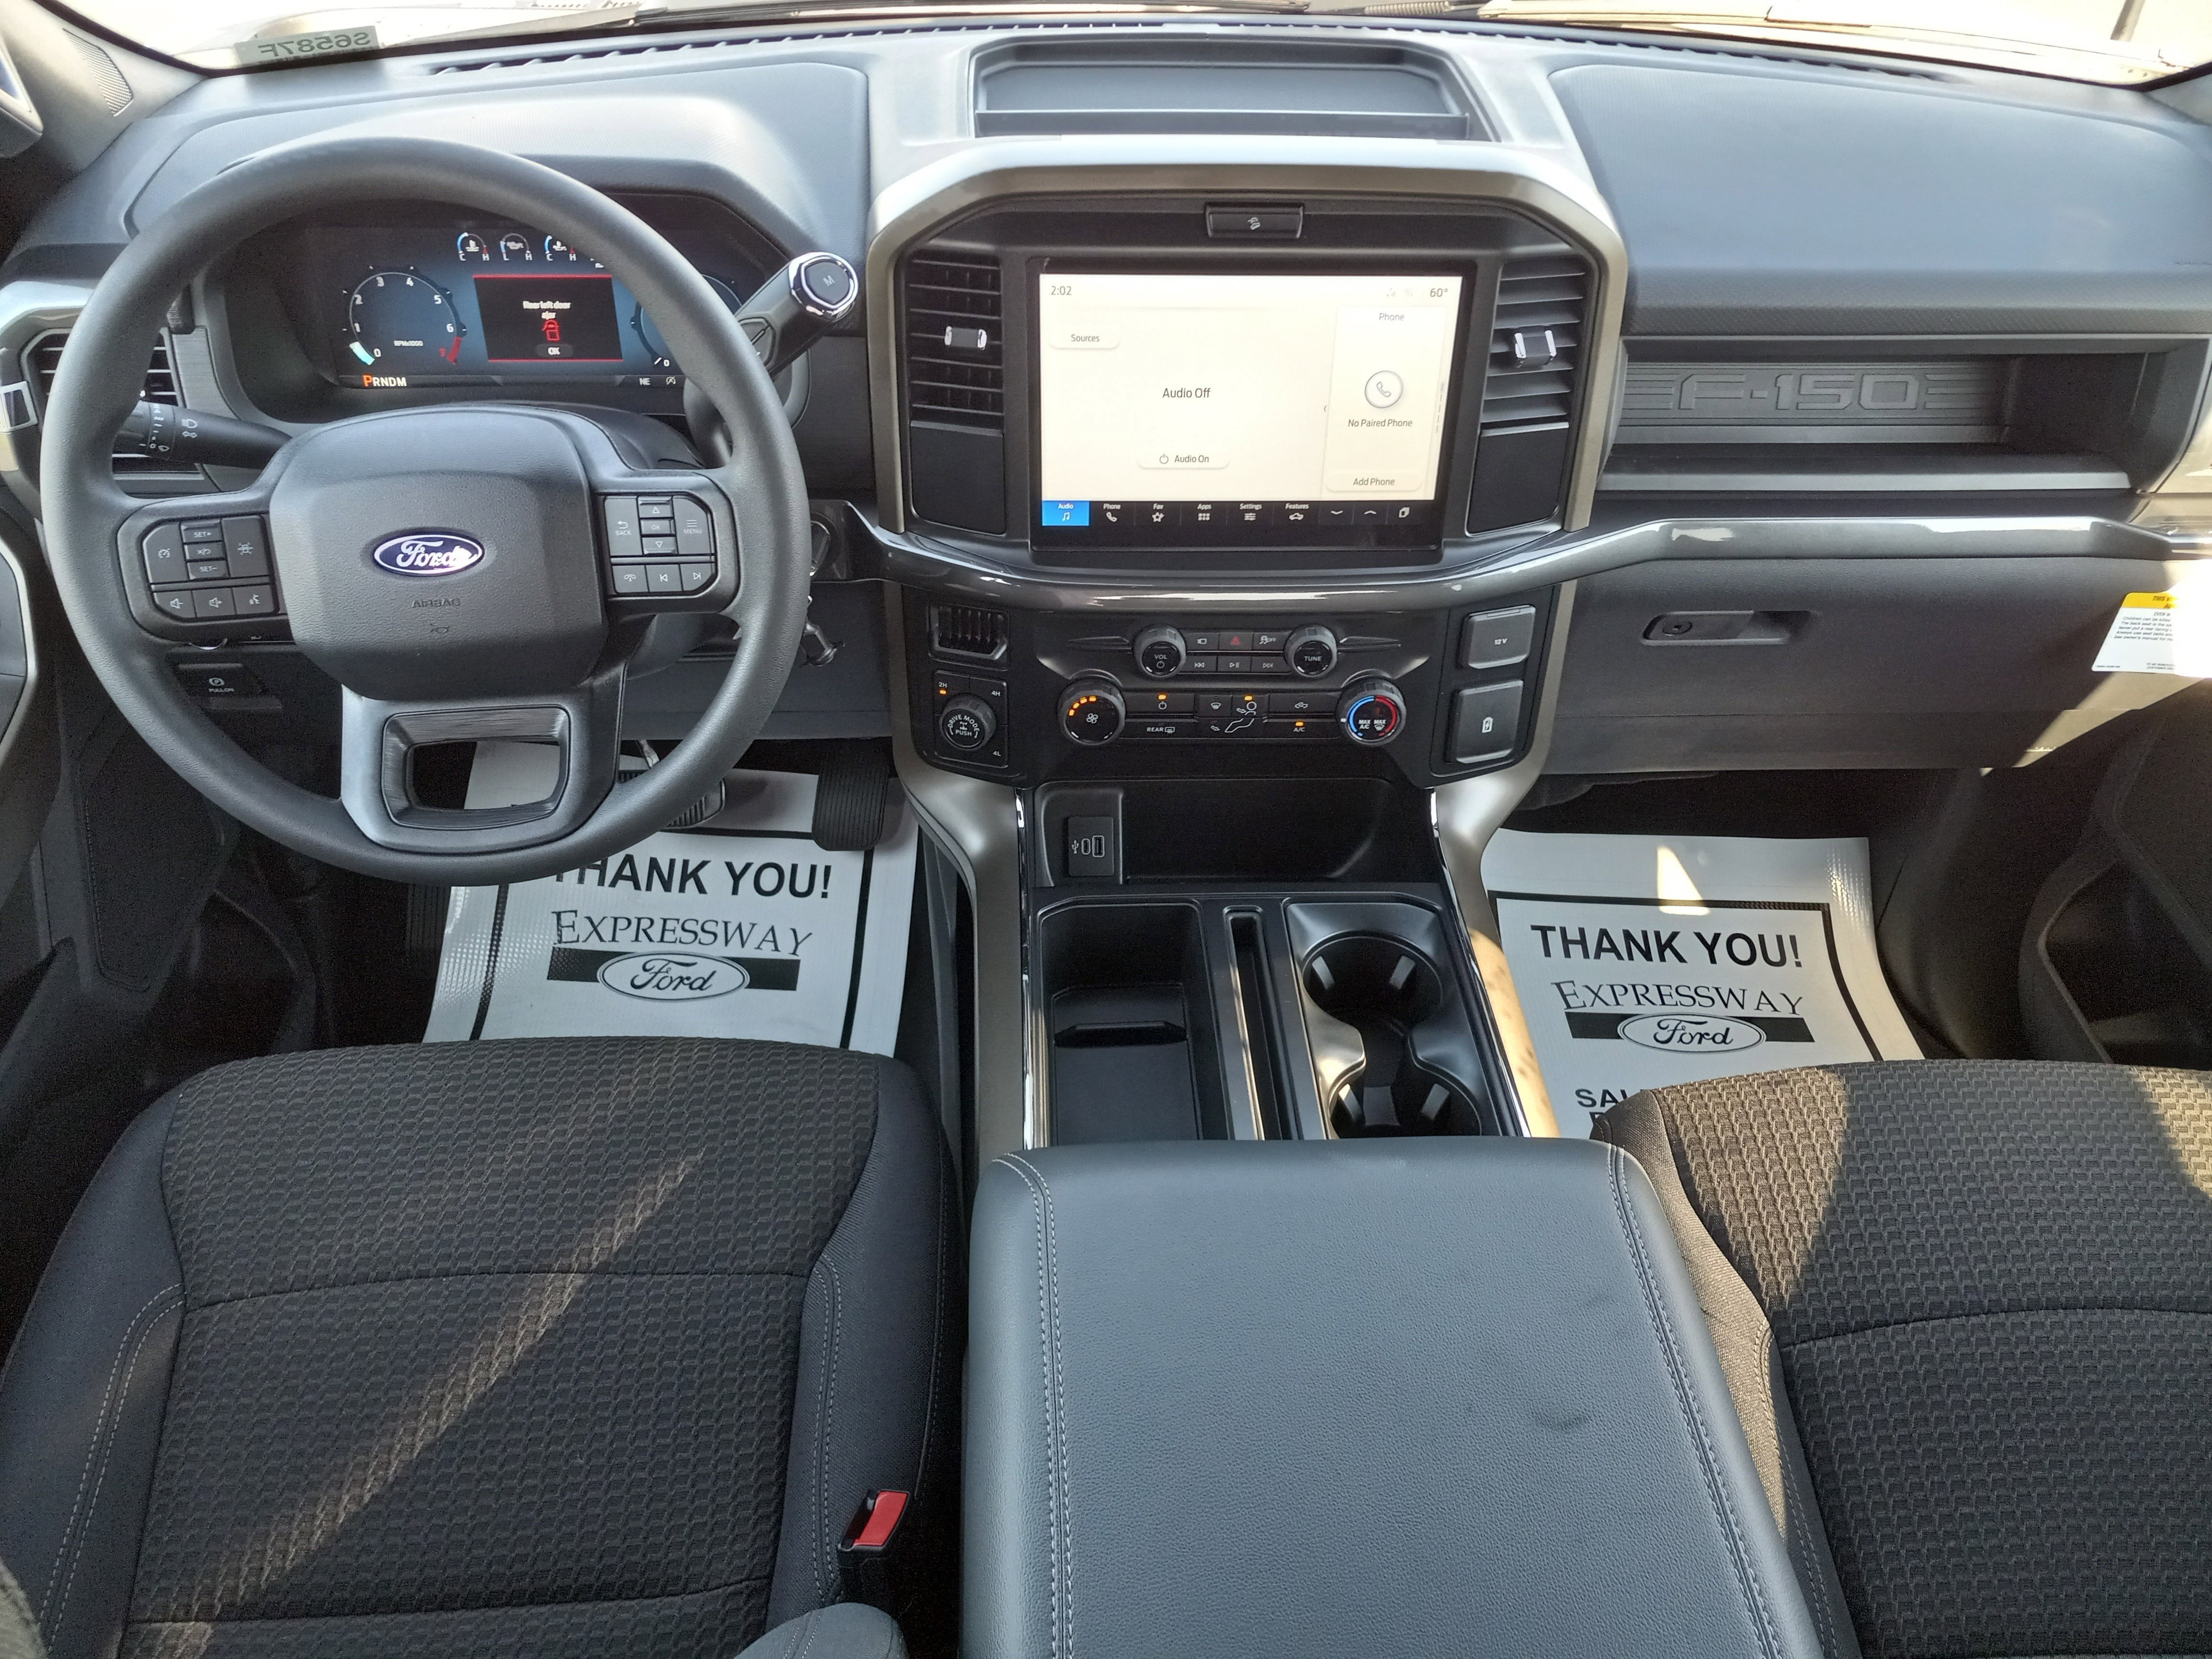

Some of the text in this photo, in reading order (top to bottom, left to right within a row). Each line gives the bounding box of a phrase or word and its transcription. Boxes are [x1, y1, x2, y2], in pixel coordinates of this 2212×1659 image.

[376, 276, 384, 287] 3
[406, 277, 414, 287] 4
[1051, 287, 1072, 296] 2:02
[354, 294, 363, 304] 2
[434, 295, 442, 304] 5
[1379, 313, 1405, 322] Phone
[354, 323, 361, 332] 1
[446, 324, 454, 333] 6
[1070, 334, 1100, 342] Sources
[373, 349, 381, 357] 0
[1162, 387, 1211, 398] Audio Off
[1678, 373, 1920, 410] F-150
[1348, 419, 1413, 427] No Paired Phone
[1174, 455, 1196, 463] Audio
[1353, 478, 1395, 486] Add Phone
[411, 599, 460, 608] AIRBAG
[948, 714, 980, 732] DRIVE MODE
[556, 853, 832, 899] HANK YOU!
[1530, 925, 1803, 968] THANK YOU!
[630, 959, 717, 992] Ford
[1653, 1018, 1734, 1046] Ford
